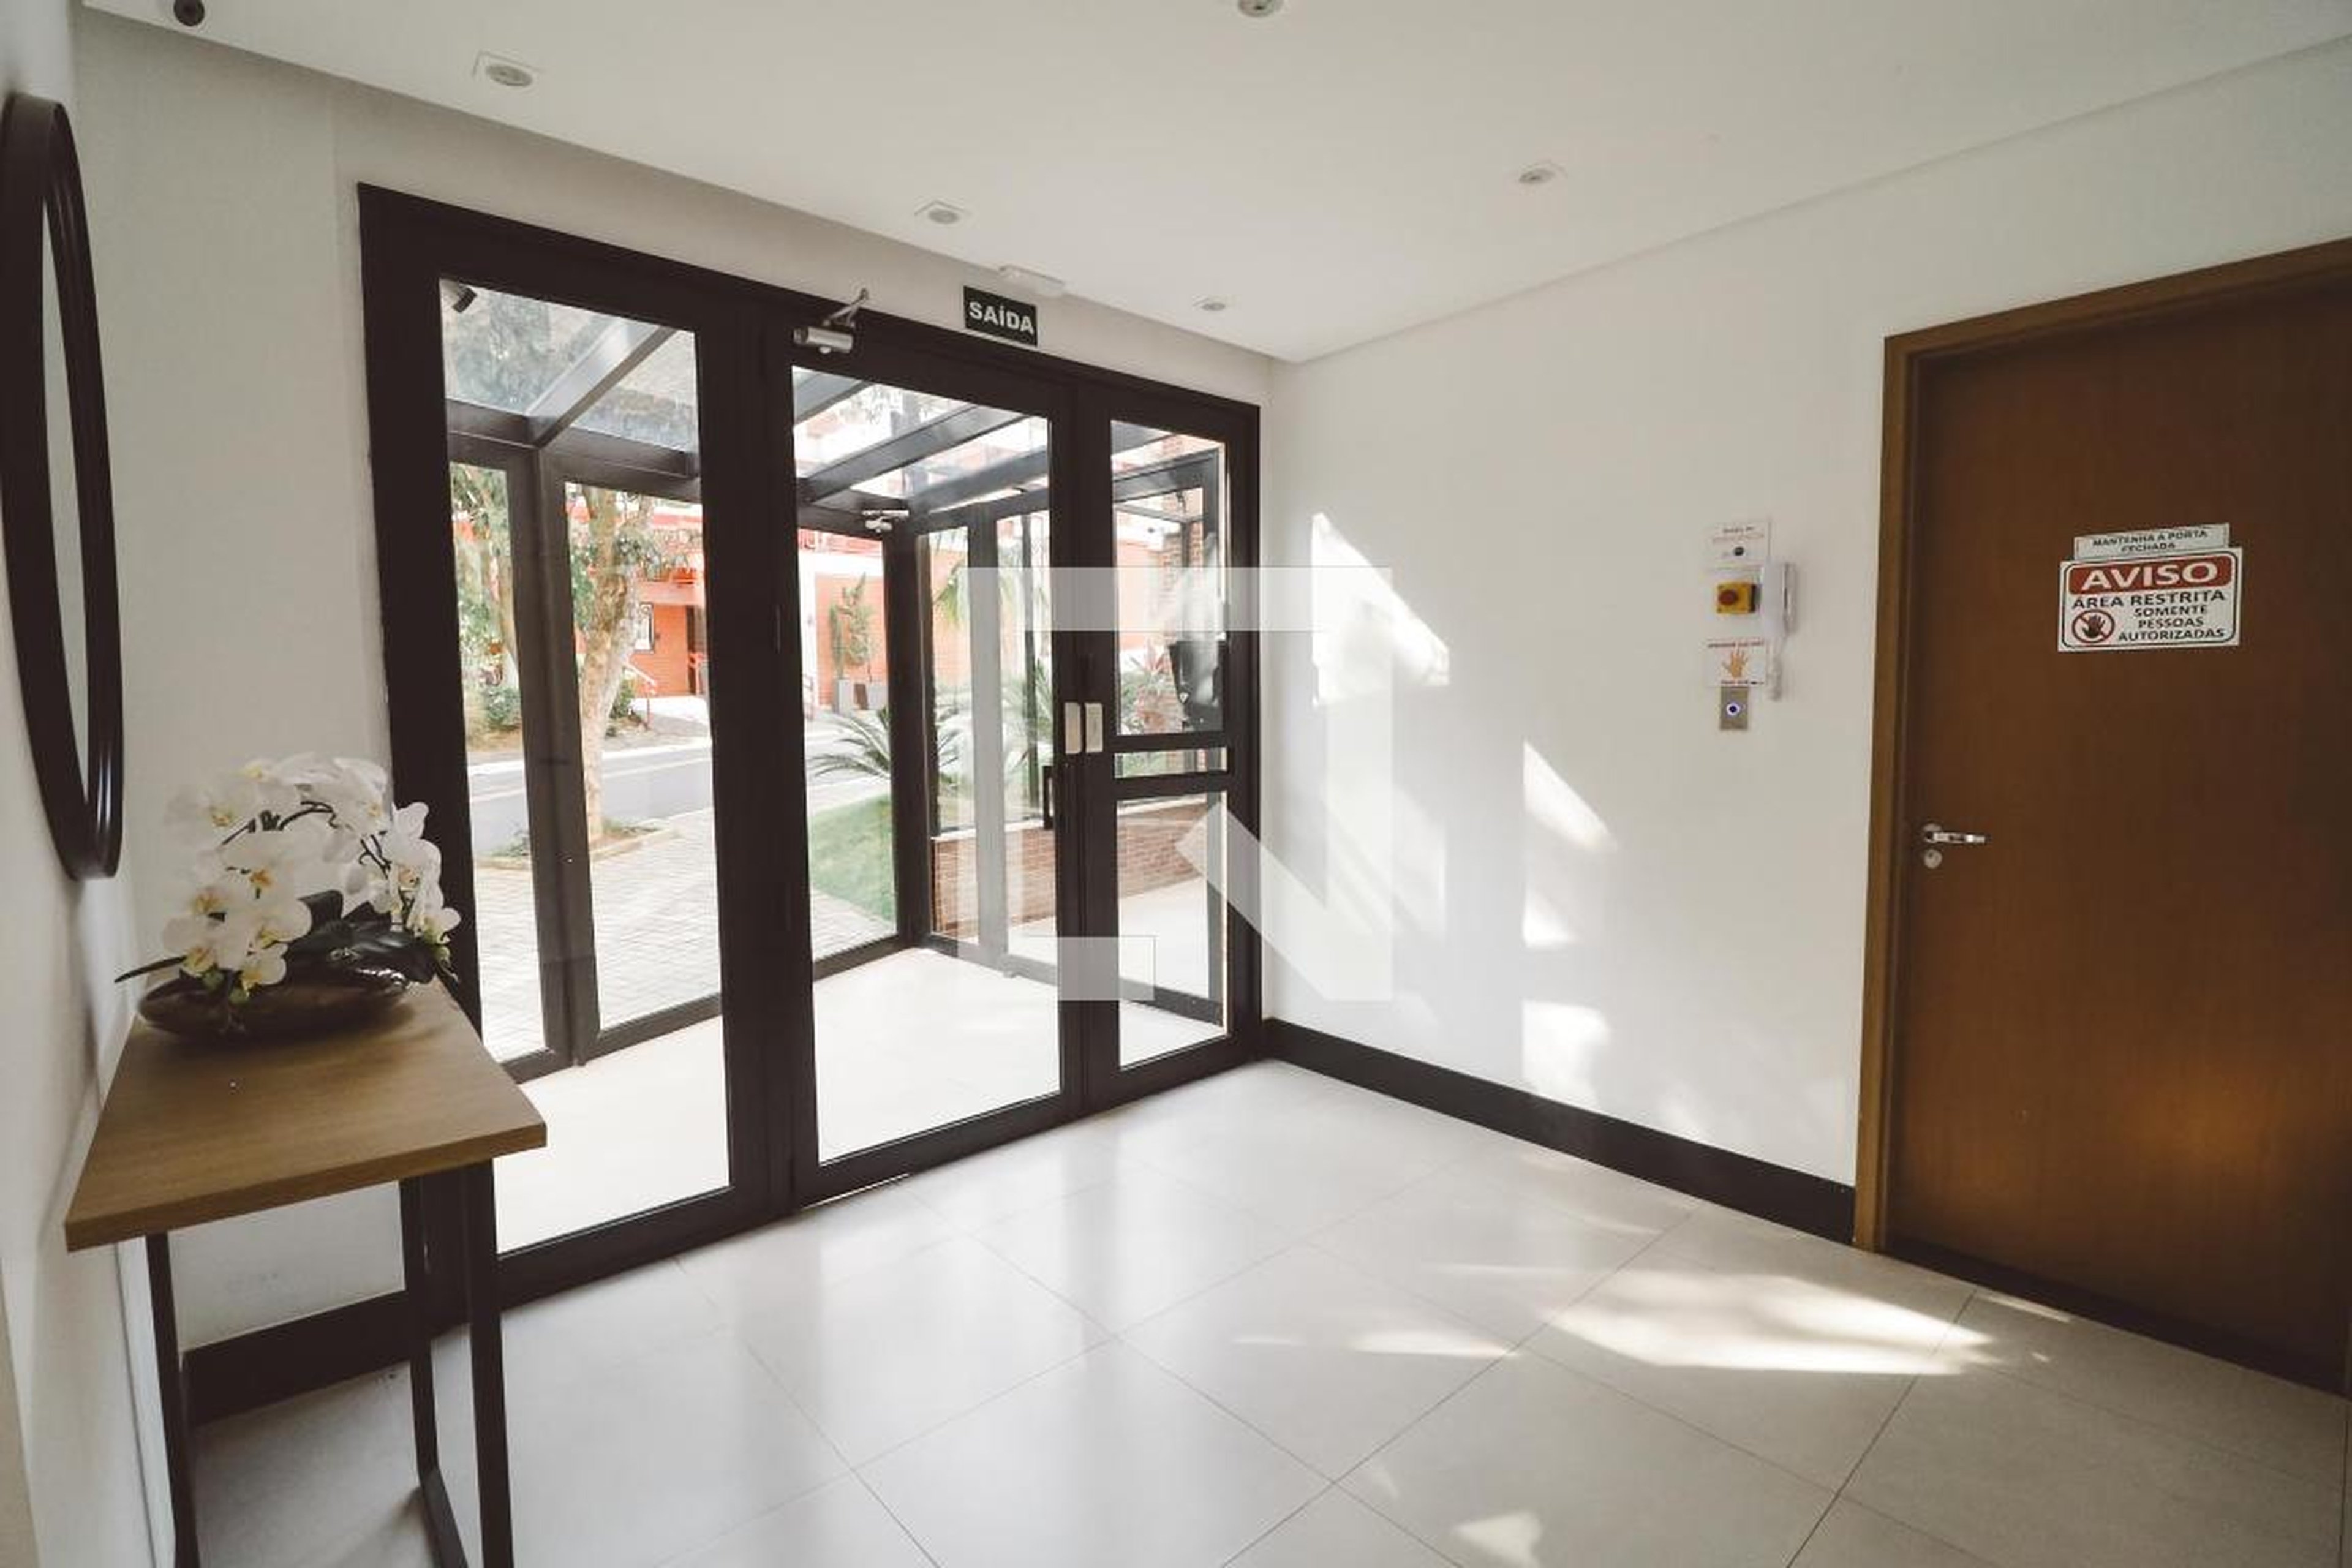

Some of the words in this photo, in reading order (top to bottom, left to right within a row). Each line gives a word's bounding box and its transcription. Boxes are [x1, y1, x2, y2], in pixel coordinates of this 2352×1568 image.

[969, 301, 1034, 334] SAÍDA
[2092, 534, 2154, 546] MANTENHA
[2168, 530, 2208, 540] PORTA
[2121, 543, 2176, 552] FECHADA
[2081, 562, 2218, 591] AVISO
[2130, 590, 2225, 606] RESTRITA
[2134, 605, 2207, 617] SOMENTE
[2138, 617, 2204, 630] PESSOAS
[2118, 628, 2225, 641] AUTORIZADAS
